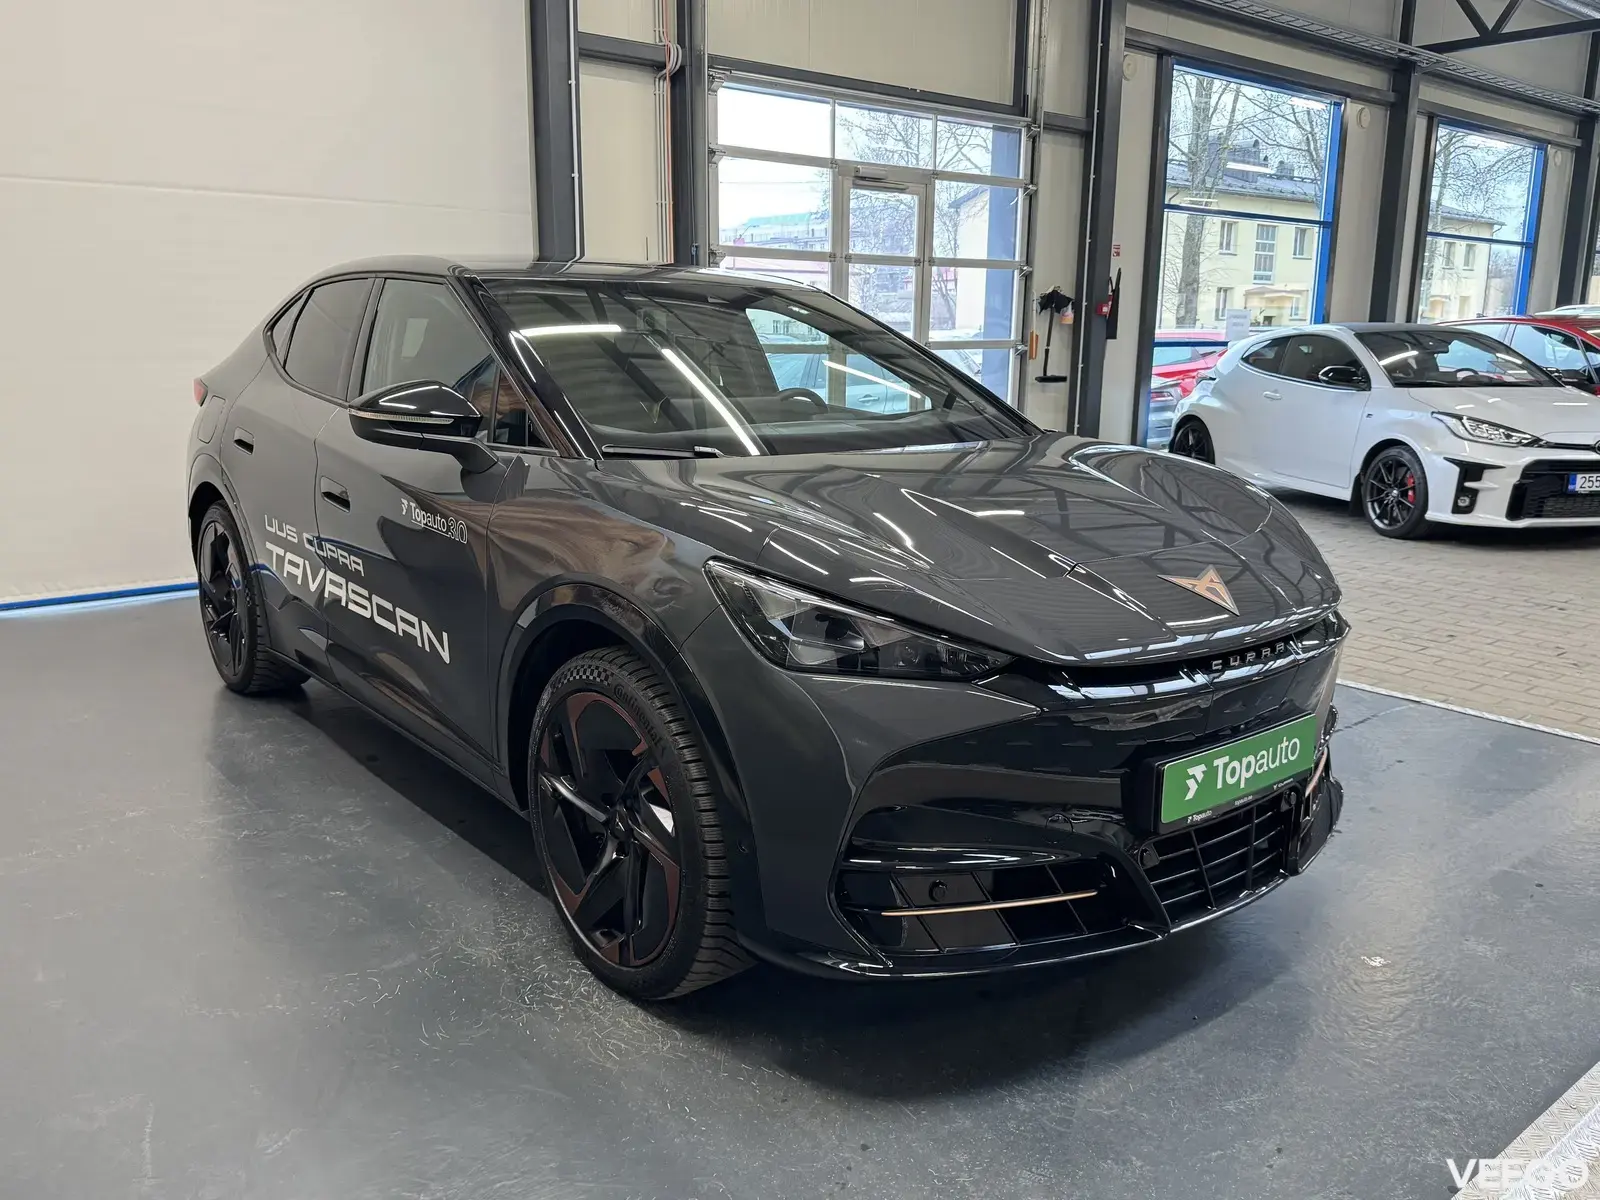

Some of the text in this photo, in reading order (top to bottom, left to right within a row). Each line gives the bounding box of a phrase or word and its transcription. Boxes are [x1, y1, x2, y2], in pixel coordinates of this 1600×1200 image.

[1579, 475, 1600, 489] 255
[410, 502, 467, 544] Topauto 30
[264, 514, 364, 576] UUS CUPRA
[265, 541, 450, 664] TAVASCAN
[1211, 641, 1286, 670] CUPRA
[1213, 736, 1300, 789] Topauto
[1193, 810, 1212, 822] Topauto
